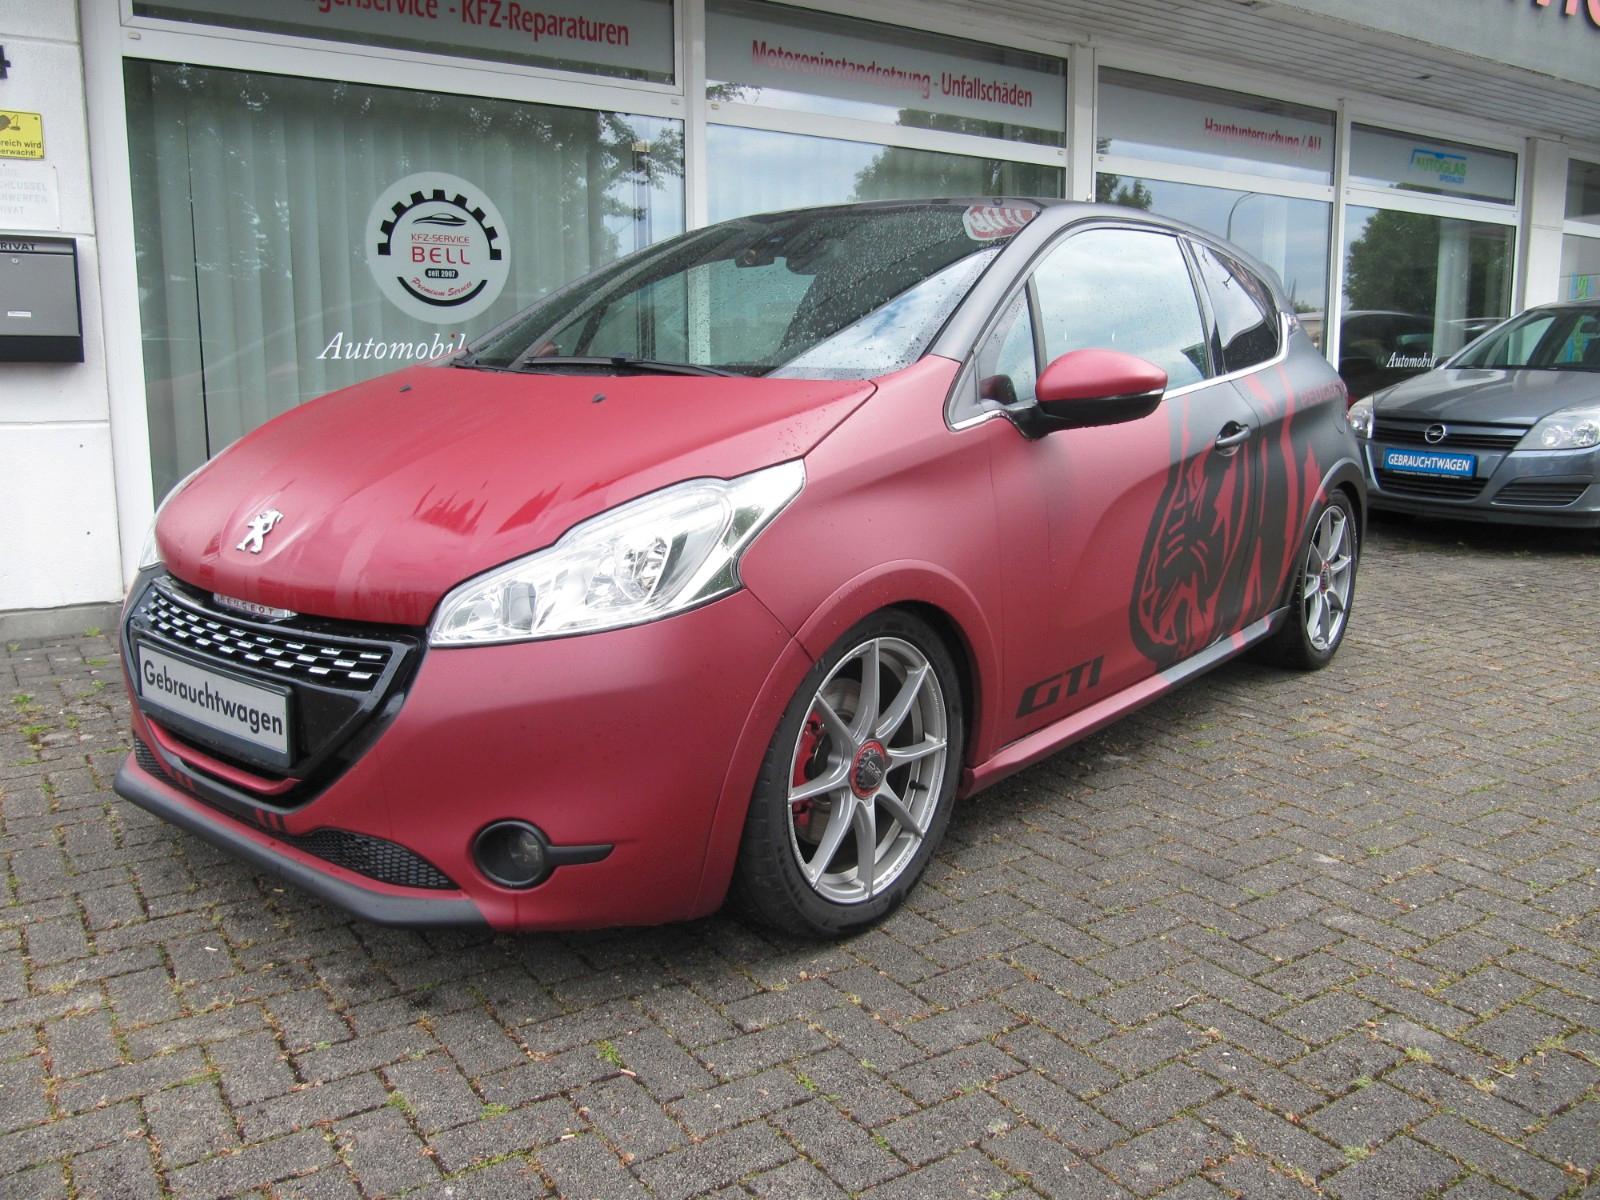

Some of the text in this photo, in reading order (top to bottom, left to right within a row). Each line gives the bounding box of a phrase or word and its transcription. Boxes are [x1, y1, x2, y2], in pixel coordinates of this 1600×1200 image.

[461, 0, 629, 46] KFZ-Reparaturen
[751, 40, 931, 99] Motoreninstandsetzung
[941, 72, 1033, 107] Unfallschäden
[24, 141, 42, 149] wird
[411, 233, 470, 244] KFZ-SERVICE
[411, 246, 471, 265] BELL
[441, 270, 456, 278] 2007
[411, 277, 445, 296] Premium
[1388, 453, 1470, 472] GEBRAUCHTWAGEN
[1015, 654, 1105, 720] GTI
[143, 659, 283, 736] Gebrauchtwagen
